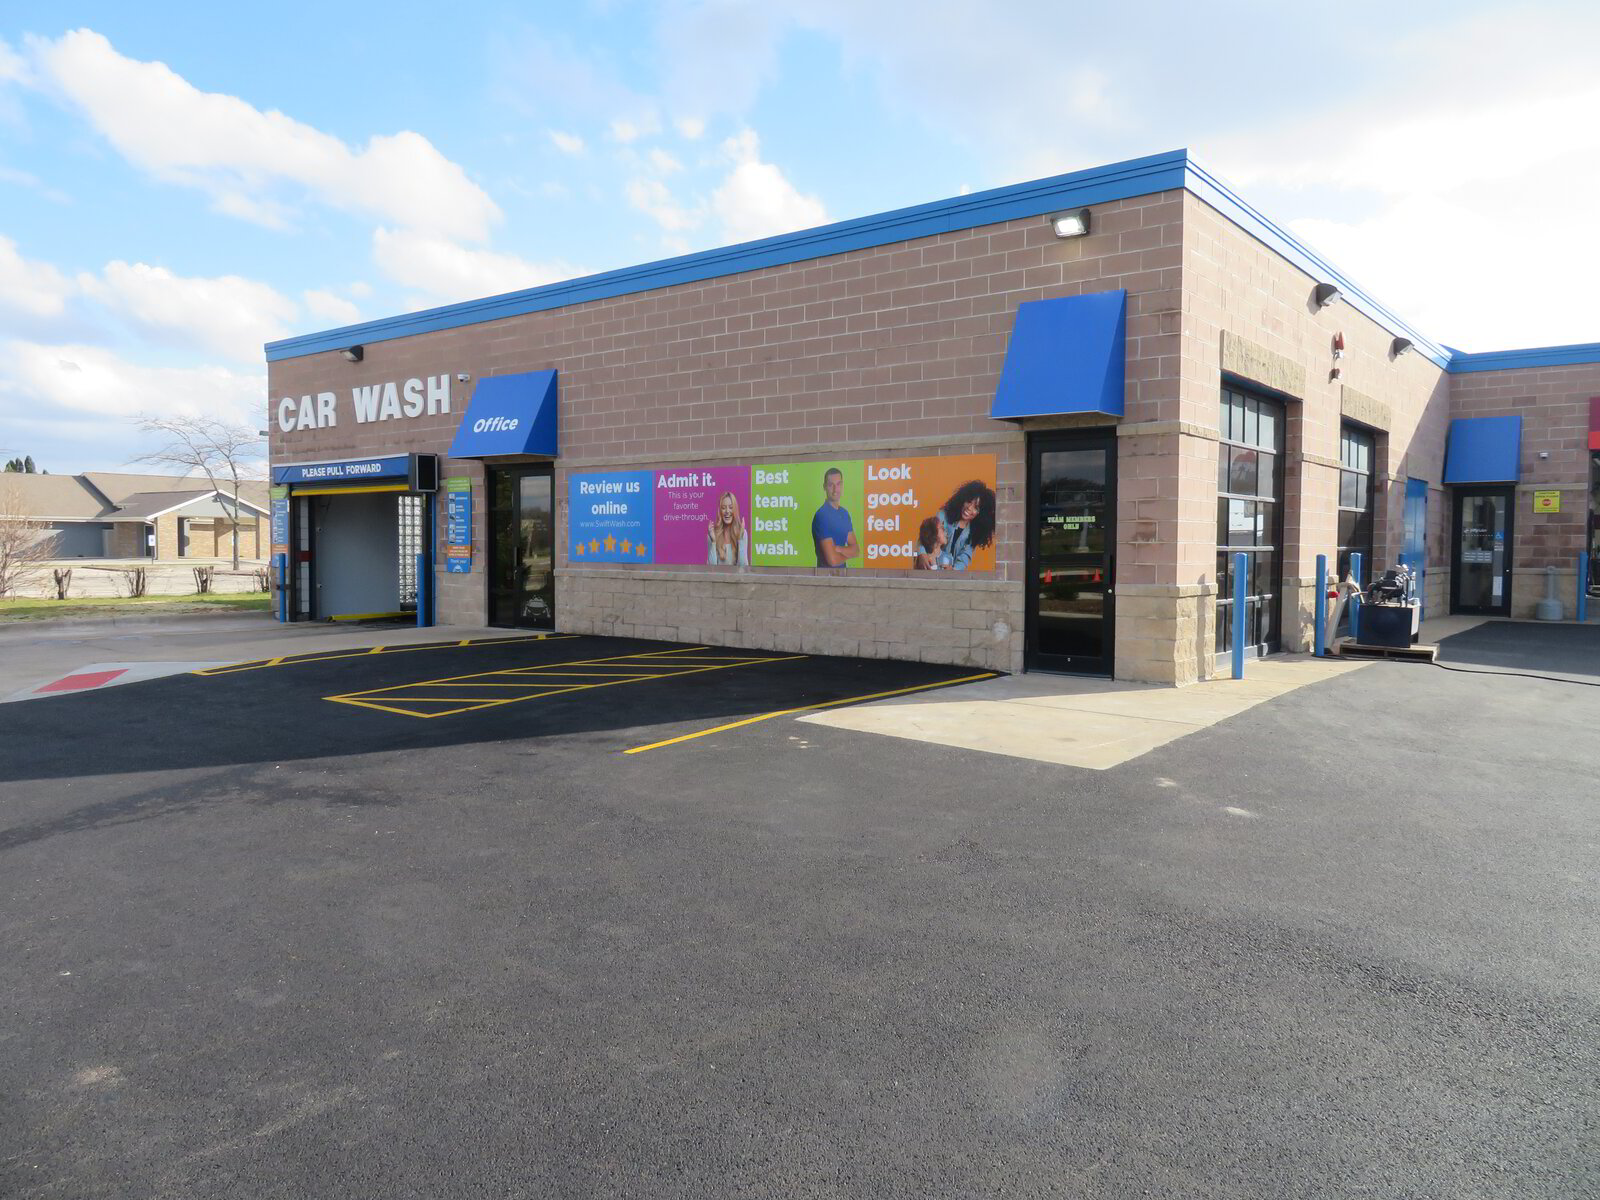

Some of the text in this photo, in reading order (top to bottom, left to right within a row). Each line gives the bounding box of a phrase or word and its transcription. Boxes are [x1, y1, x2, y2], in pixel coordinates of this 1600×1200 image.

[278, 374, 451, 433] CAR WASH
[473, 416, 519, 433] Office
[302, 463, 382, 478] PLEASE PULL FORWARD
[755, 469, 789, 485] Best
[867, 464, 911, 481] Look
[580, 480, 640, 494] Review us
[657, 473, 716, 489] Admit it.
[668, 491, 704, 501] This is your
[755, 494, 798, 511] team,
[867, 489, 919, 509] good,
[591, 501, 628, 515] online
[673, 502, 699, 510] favorite
[755, 516, 788, 532] best
[867, 515, 900, 532] feel
[1066, 515, 1096, 523] MEMBERS
[755, 540, 798, 556] wash.
[867, 541, 918, 559] good.
